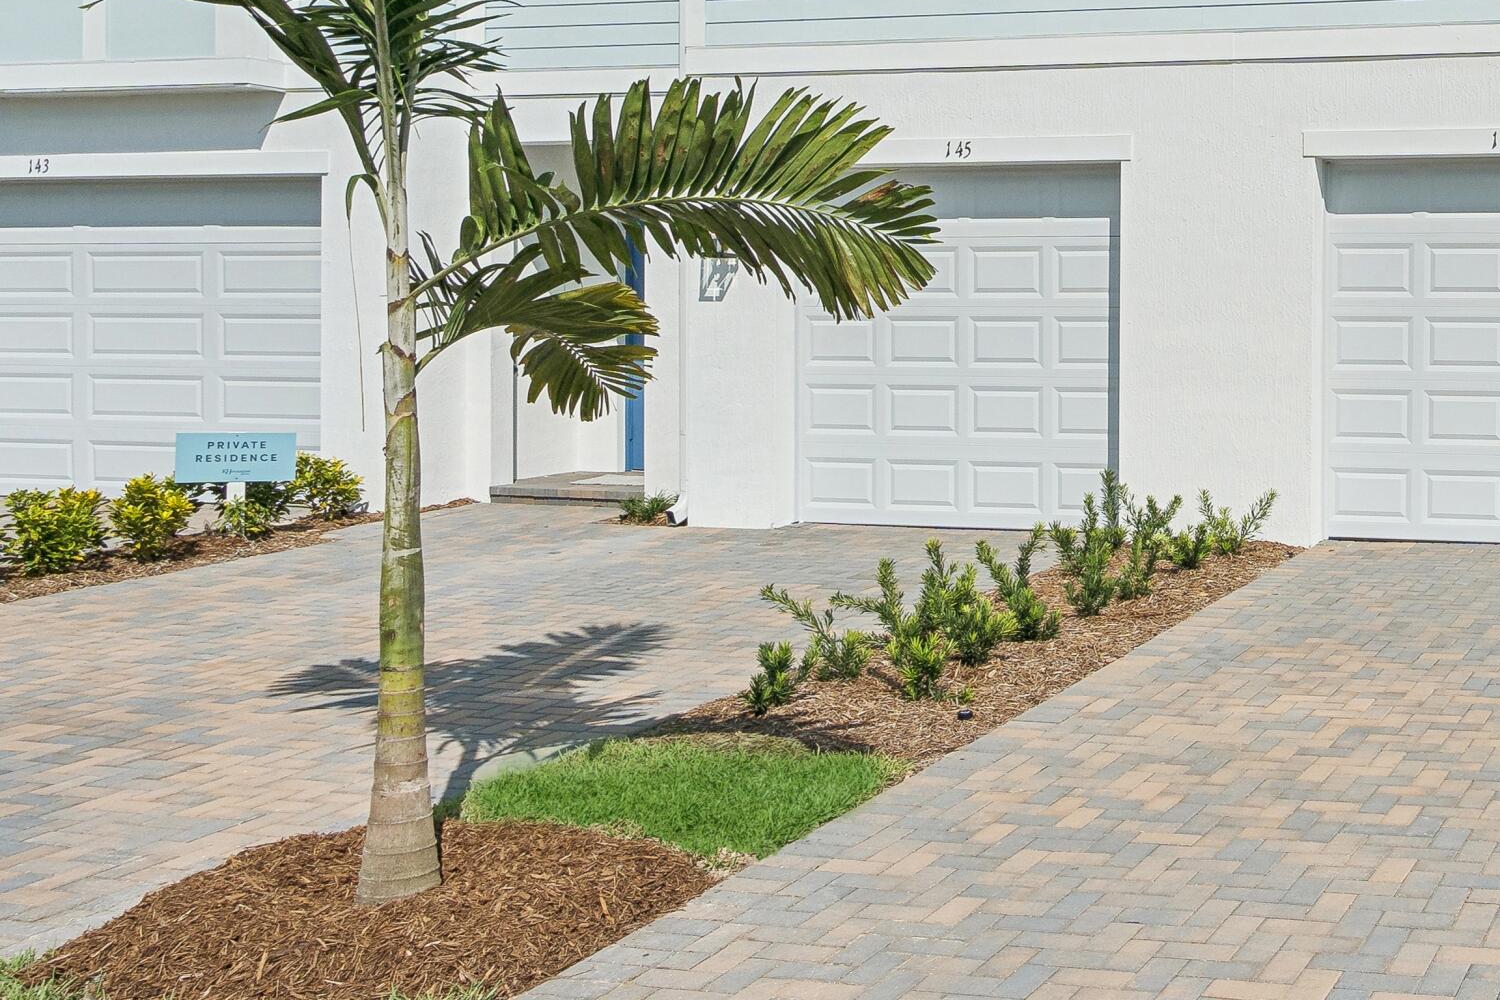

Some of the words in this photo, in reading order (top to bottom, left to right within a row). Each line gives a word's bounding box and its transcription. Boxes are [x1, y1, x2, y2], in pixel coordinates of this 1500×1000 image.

[945, 141, 972, 158] 145
[28, 158, 49, 174] 143
[207, 441, 267, 449] PRIVATE
[195, 453, 278, 462] RESIDENCE
